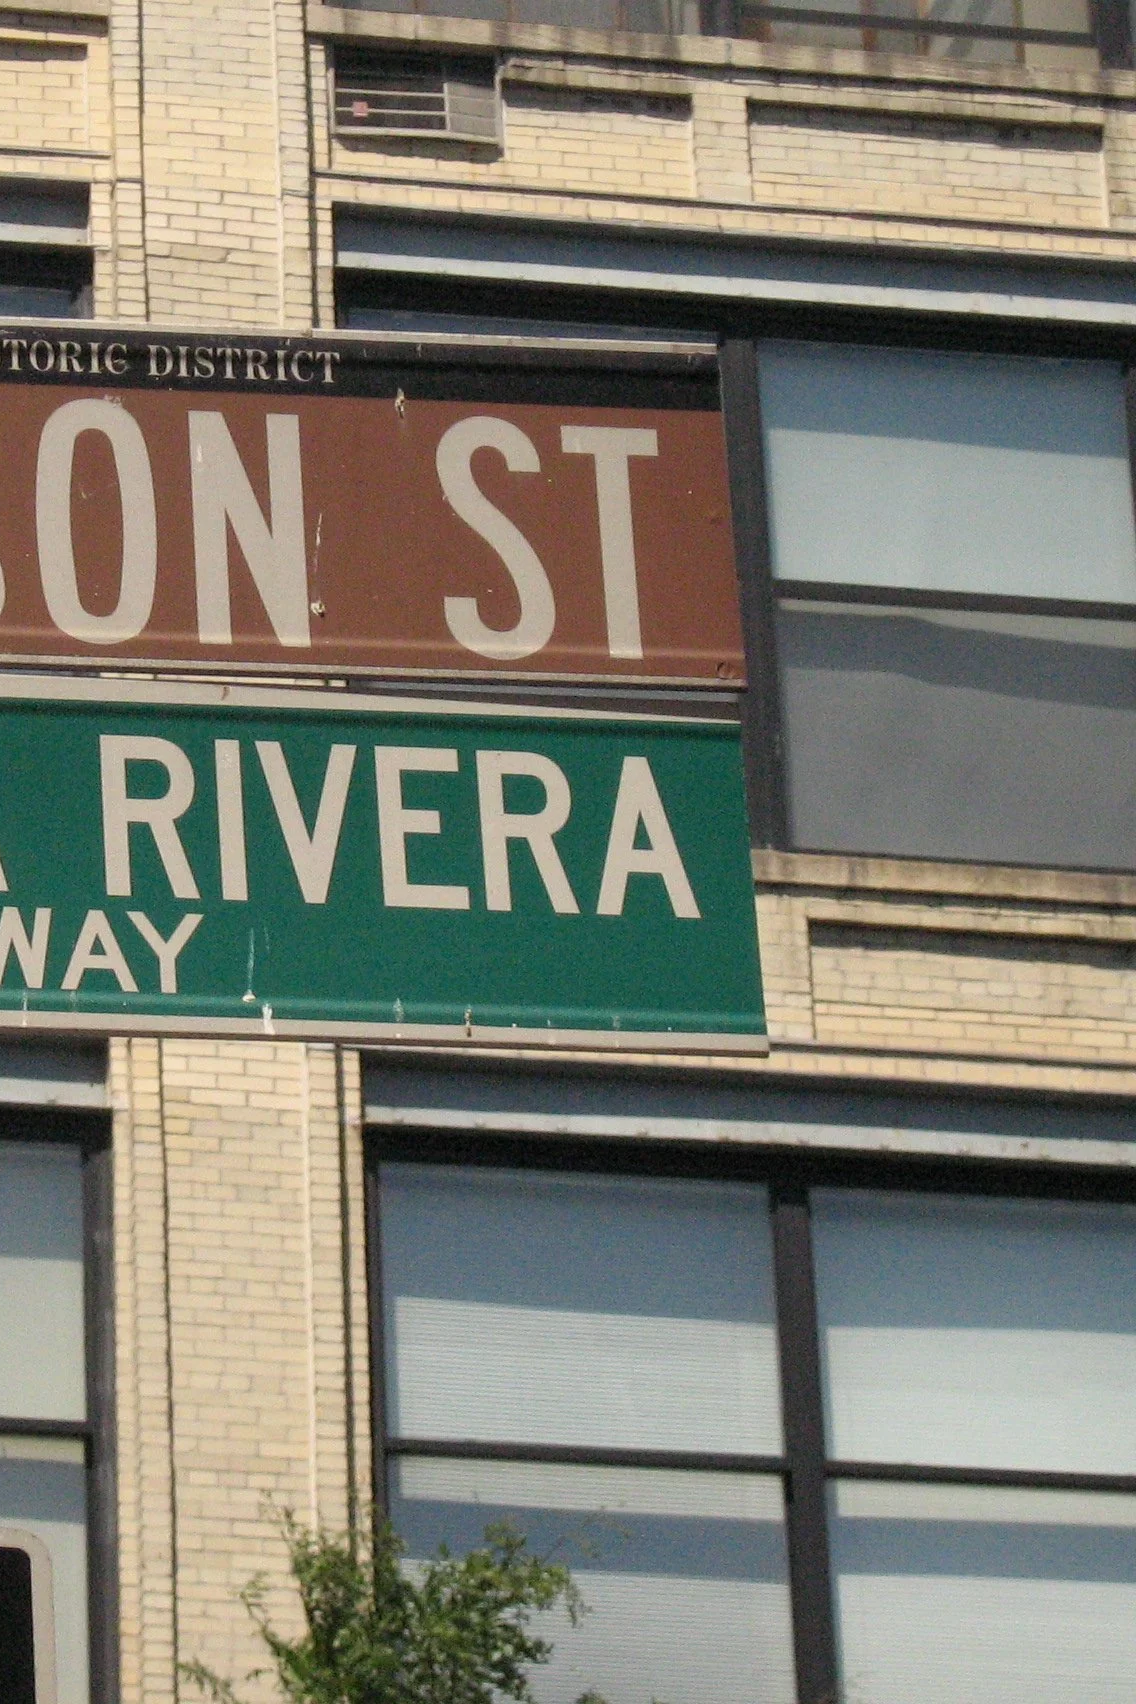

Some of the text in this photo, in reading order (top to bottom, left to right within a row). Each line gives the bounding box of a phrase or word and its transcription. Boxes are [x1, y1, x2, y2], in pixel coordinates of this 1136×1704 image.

[146, 344, 341, 384] DISTRICT
[435, 415, 659, 661] ST
[98, 733, 702, 919] RIVERA
